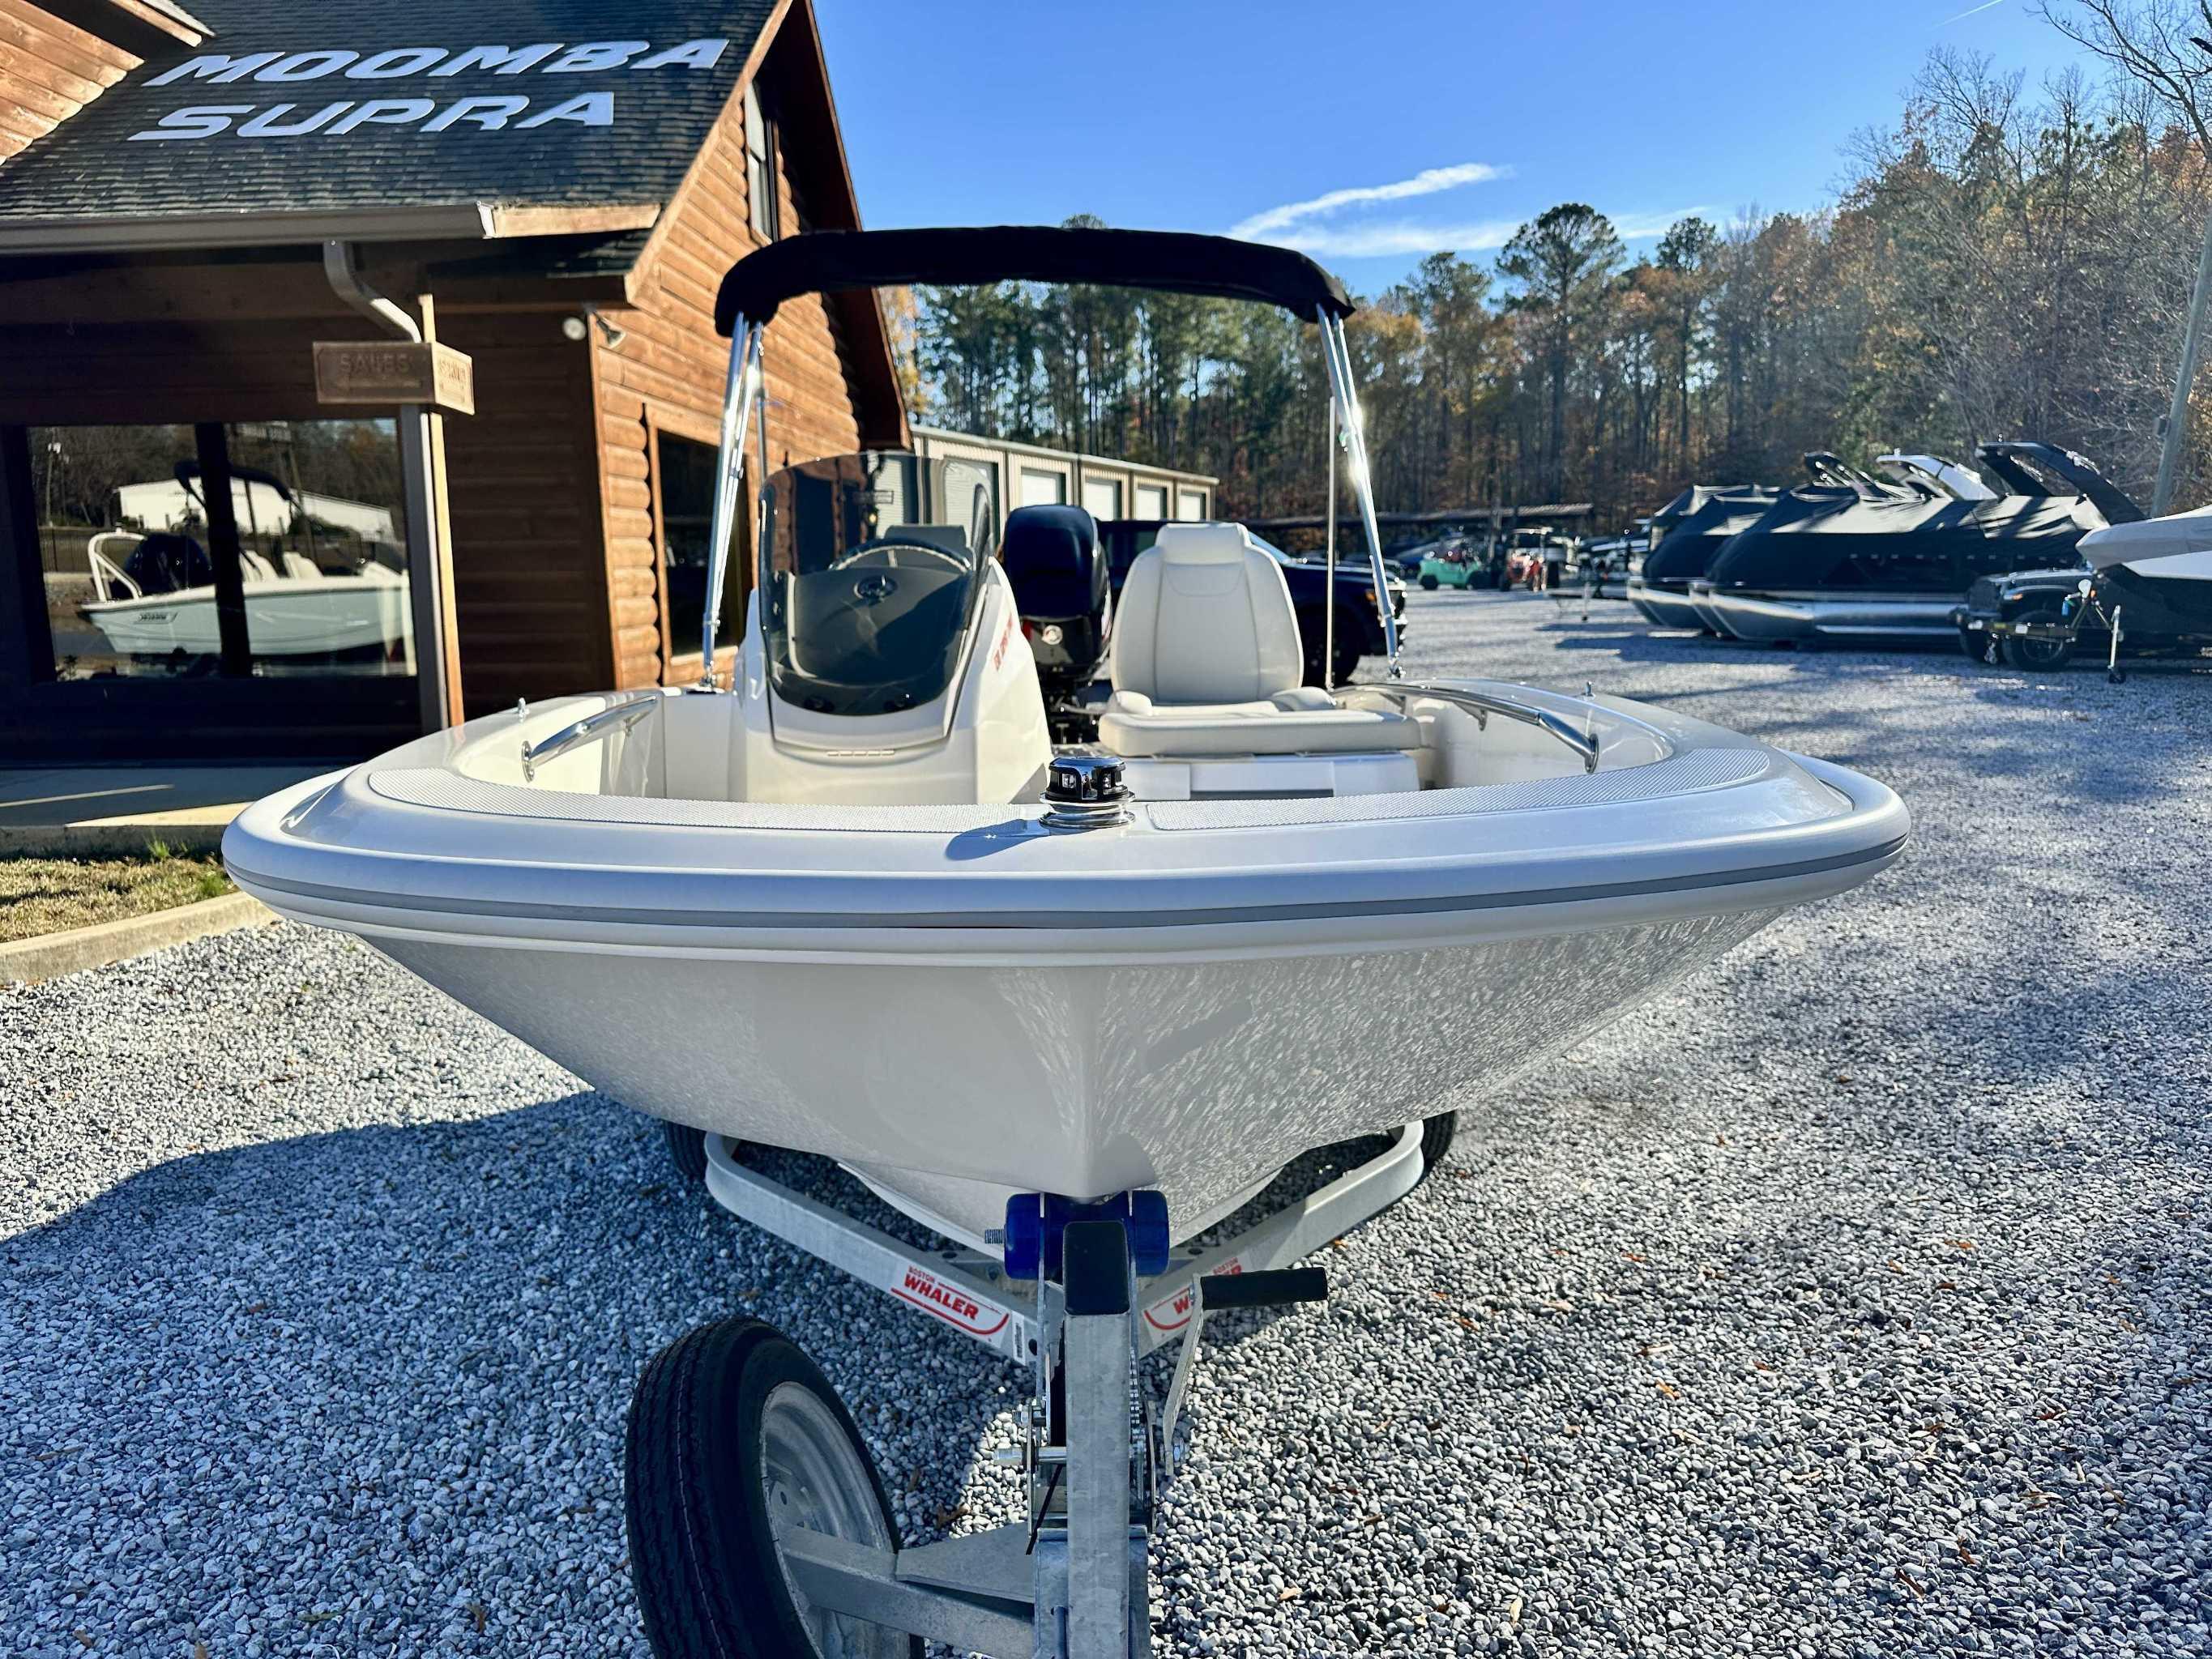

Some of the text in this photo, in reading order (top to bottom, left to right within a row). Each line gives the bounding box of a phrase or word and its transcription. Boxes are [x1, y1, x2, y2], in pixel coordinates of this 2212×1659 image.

[142, 38, 731, 87] MOOMBA
[126, 91, 616, 141] SUPRA
[903, 1273, 980, 1320] WHALER
[907, 1265, 936, 1284] BOSTON
